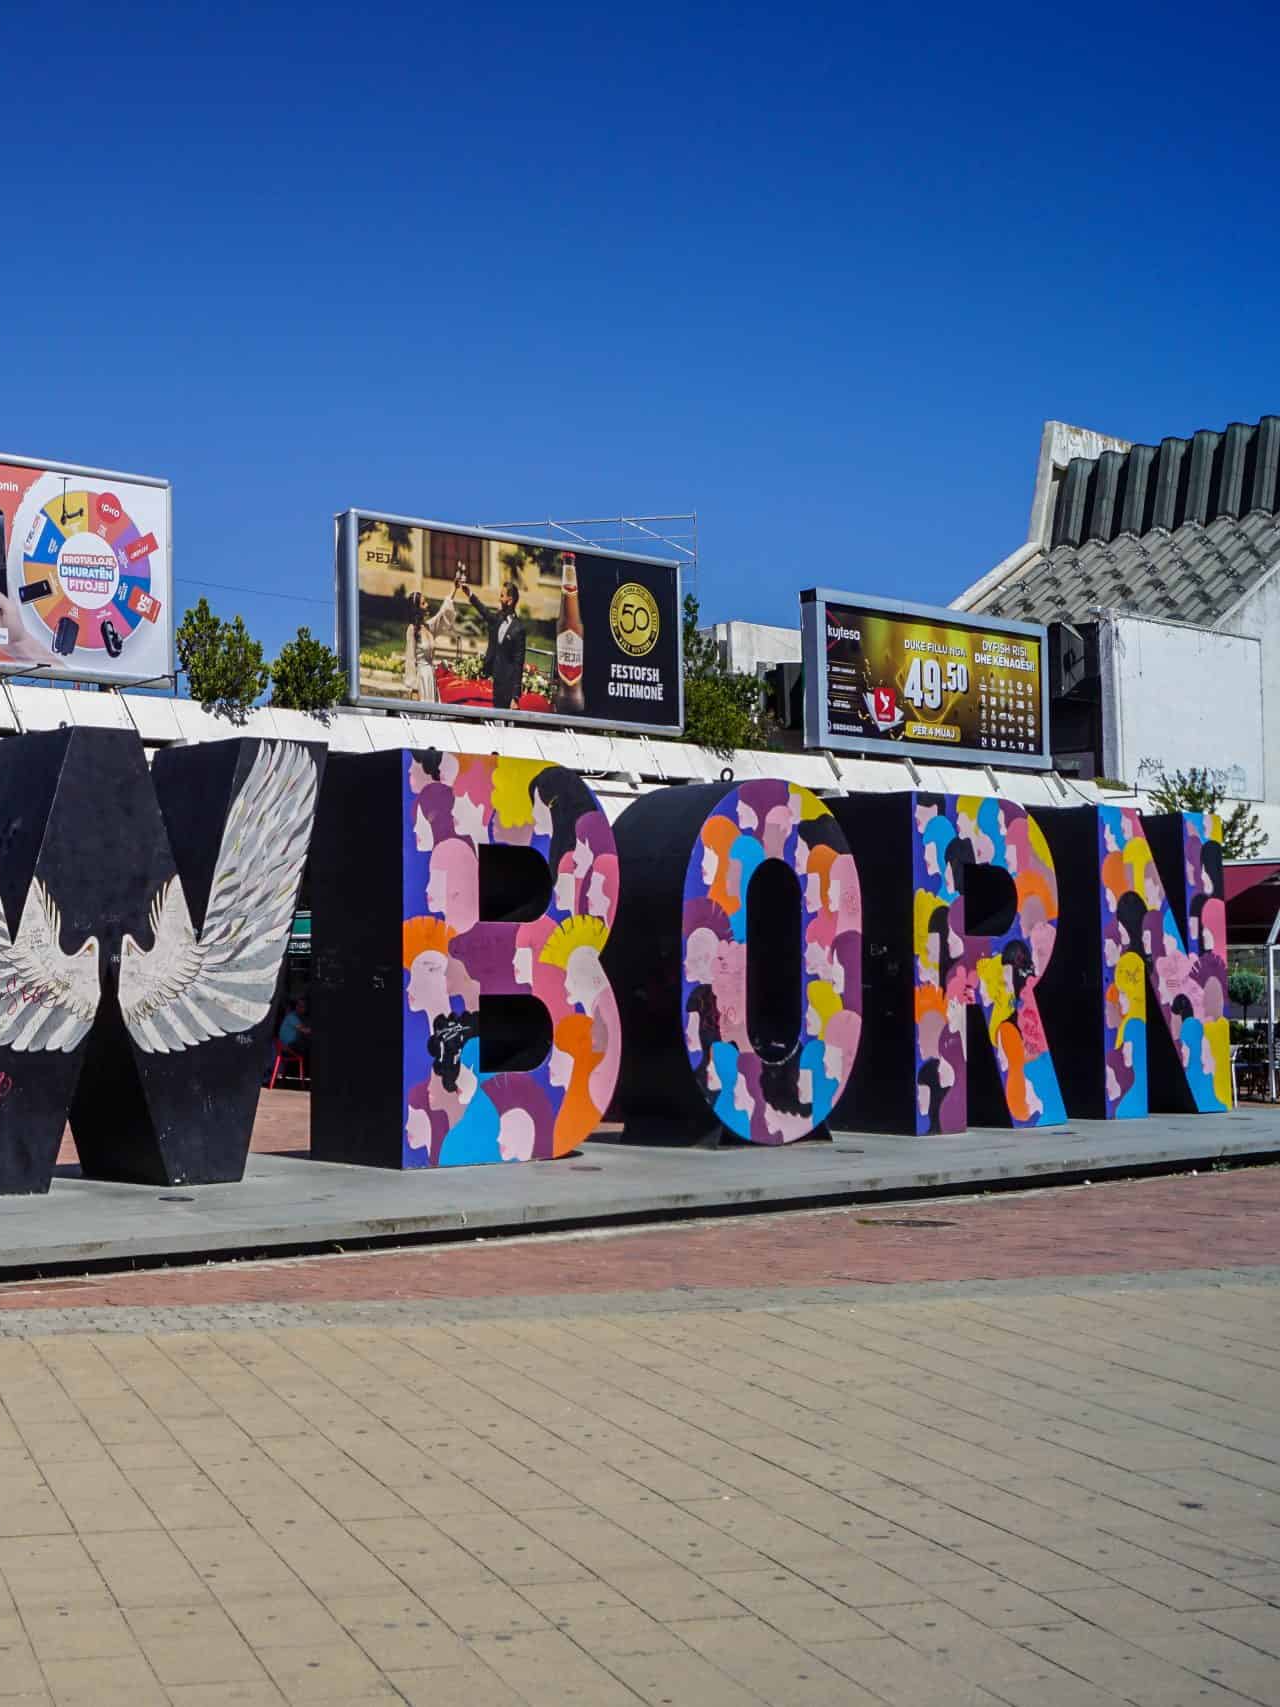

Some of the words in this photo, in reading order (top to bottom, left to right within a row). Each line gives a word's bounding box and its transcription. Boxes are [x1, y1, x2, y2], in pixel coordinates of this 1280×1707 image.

[61, 565, 113, 580] DHURATËN
[620, 603, 650, 634] 50
[827, 625, 860, 641] kujtesa
[611, 663, 660, 683] FESTOFSH
[607, 682, 664, 701] GJITHMONË
